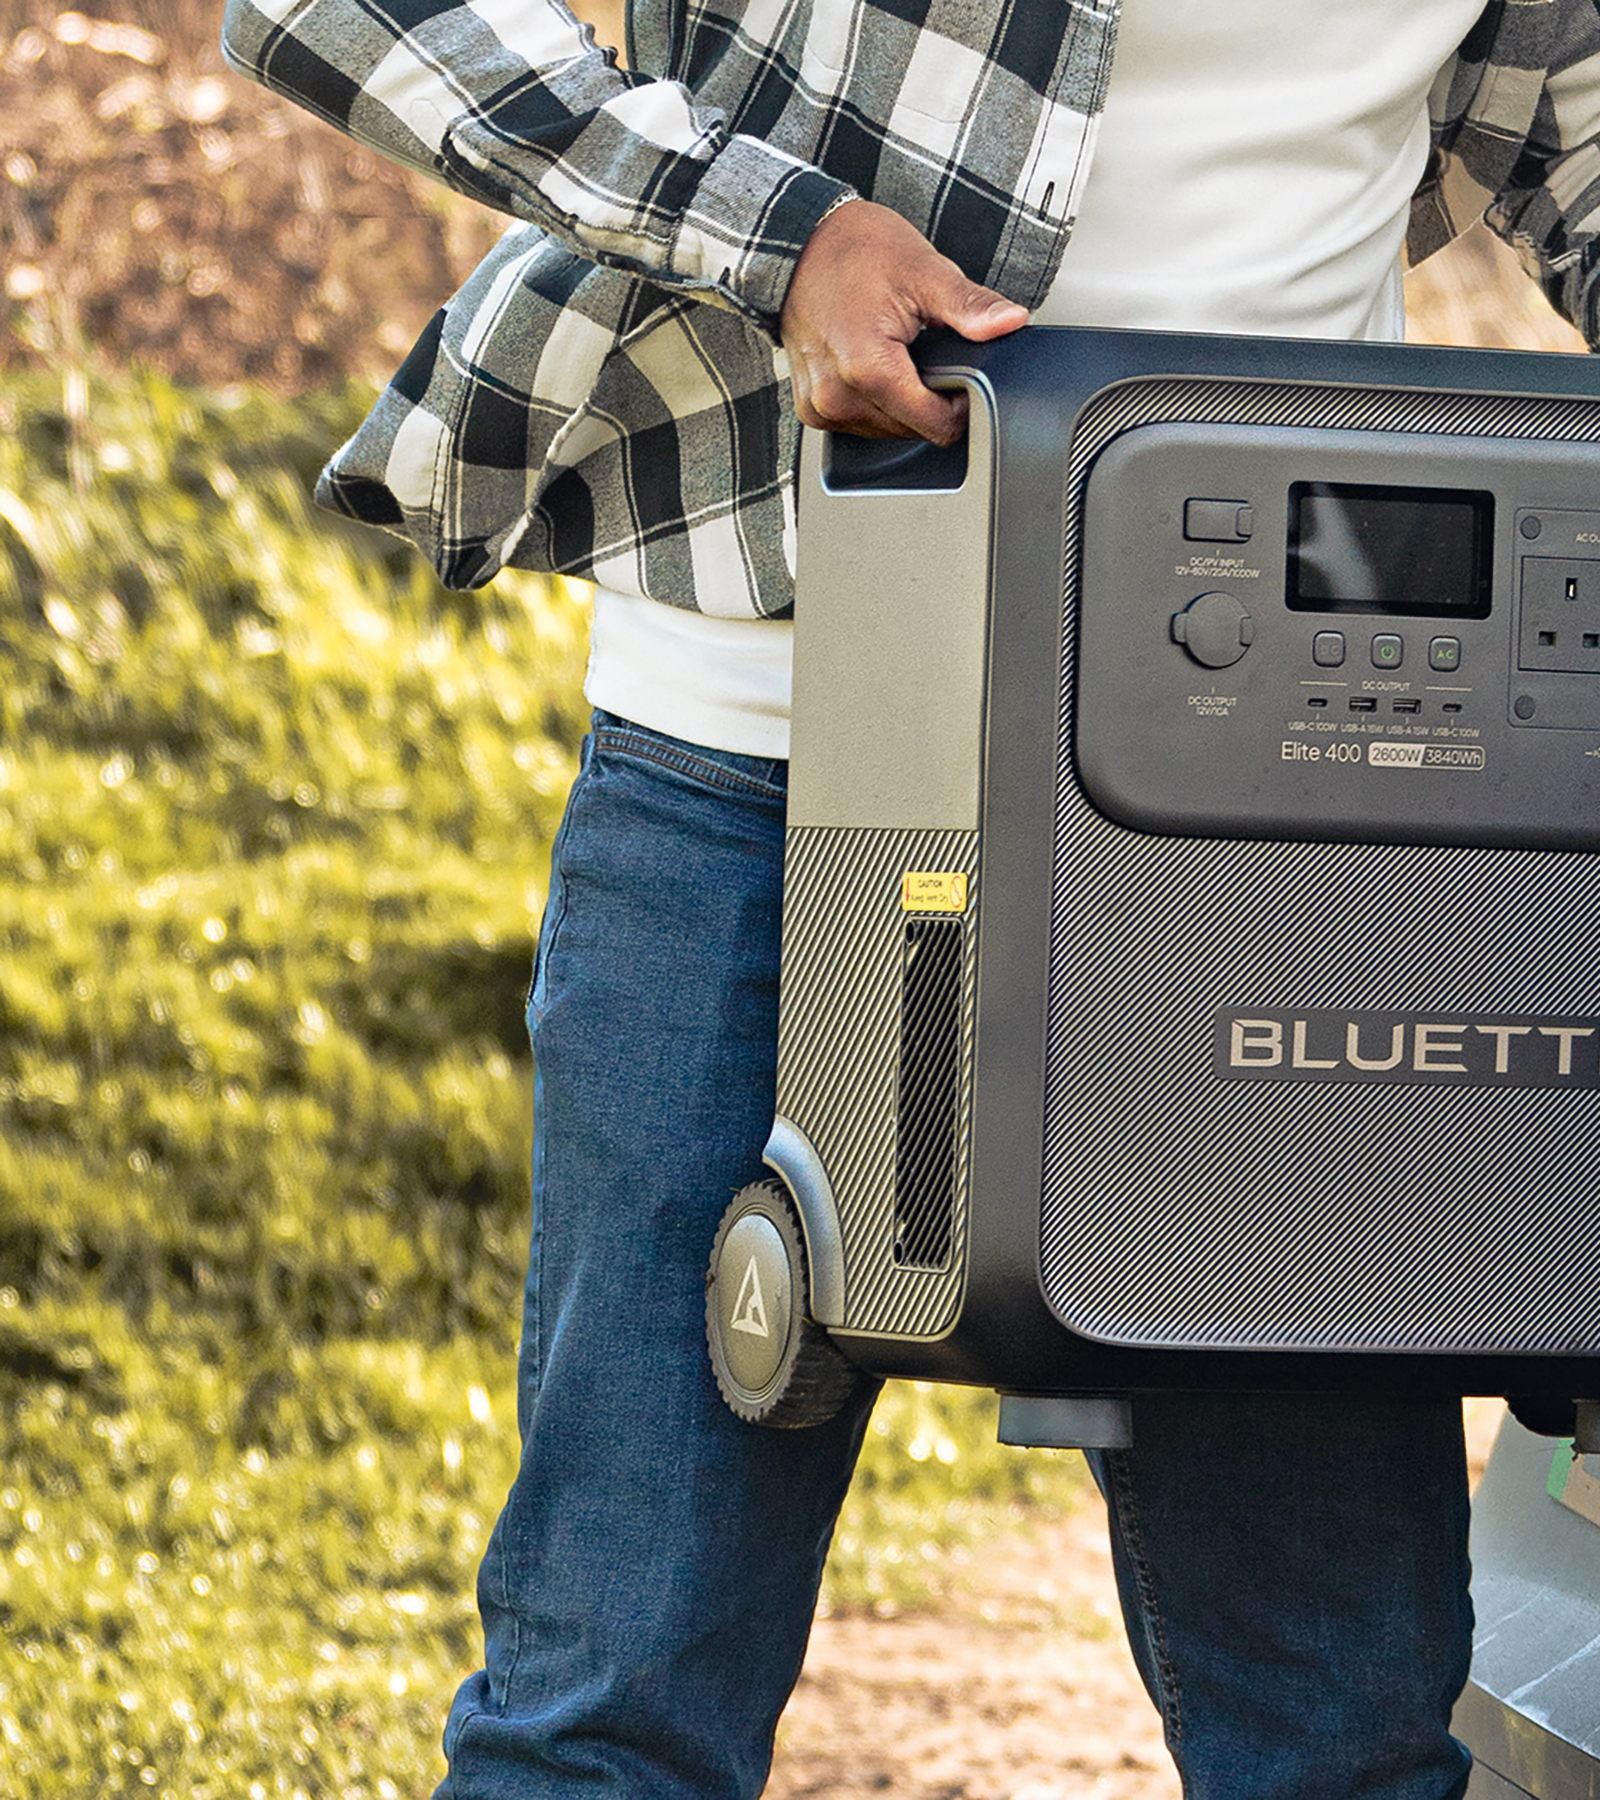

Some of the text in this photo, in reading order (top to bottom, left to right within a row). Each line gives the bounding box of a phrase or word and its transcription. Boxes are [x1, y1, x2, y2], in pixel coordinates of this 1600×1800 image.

[1576, 533, 1588, 543] AC
[1219, 559, 1245, 568] INPUT
[1436, 649, 1455, 660] AC
[1362, 680, 1411, 691] DC OUTPUT
[1188, 696, 1237, 707] DC OUTPUT
[1281, 741, 1481, 765] Elite 400 2600W 3840Wh
